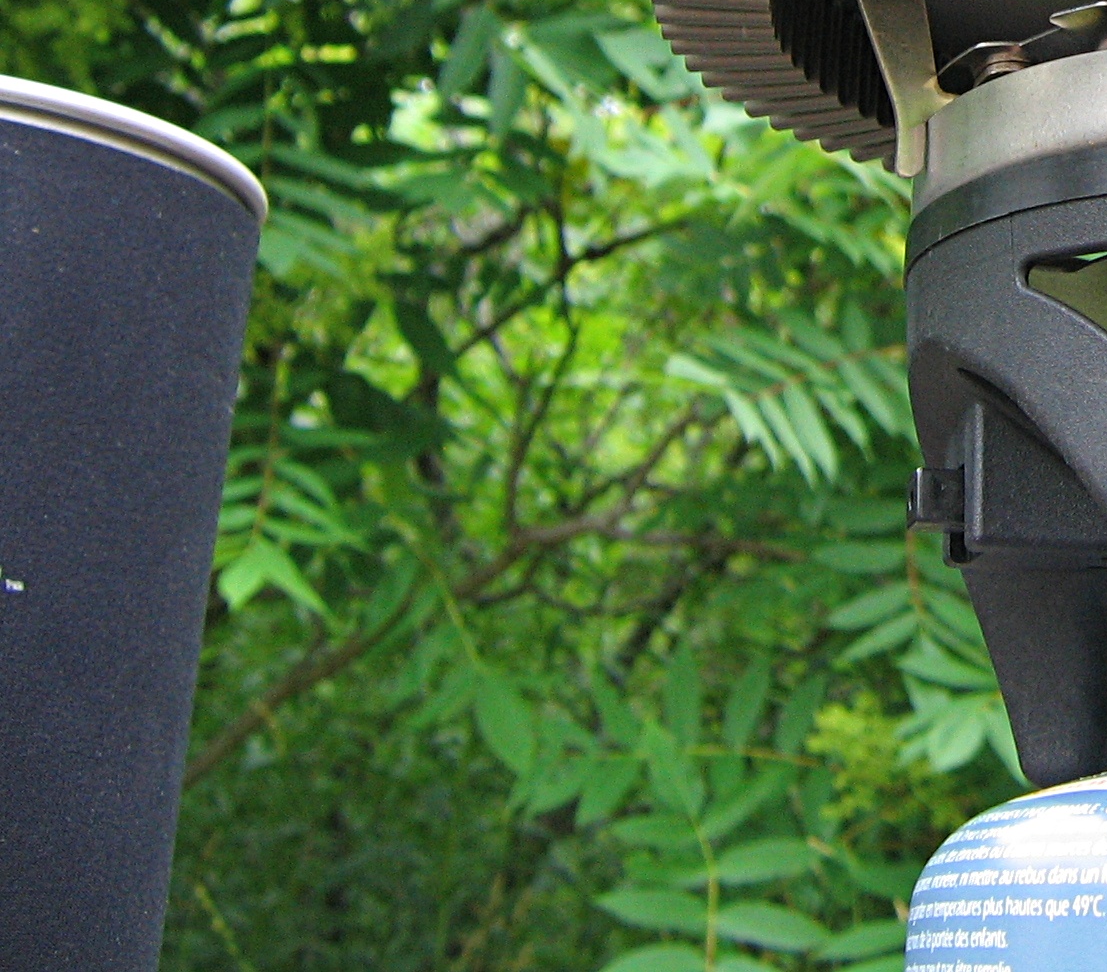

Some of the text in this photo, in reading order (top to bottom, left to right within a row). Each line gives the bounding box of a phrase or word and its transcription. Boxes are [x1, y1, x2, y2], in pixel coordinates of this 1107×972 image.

[1014, 865, 1047, 885] rebus
[1047, 865, 1078, 885] dans
[1080, 867, 1100, 885] un
[982, 896, 1003, 922] plus
[1005, 895, 1043, 917] hautes
[1045, 898, 1070, 922] que
[955, 928, 969, 948] des
